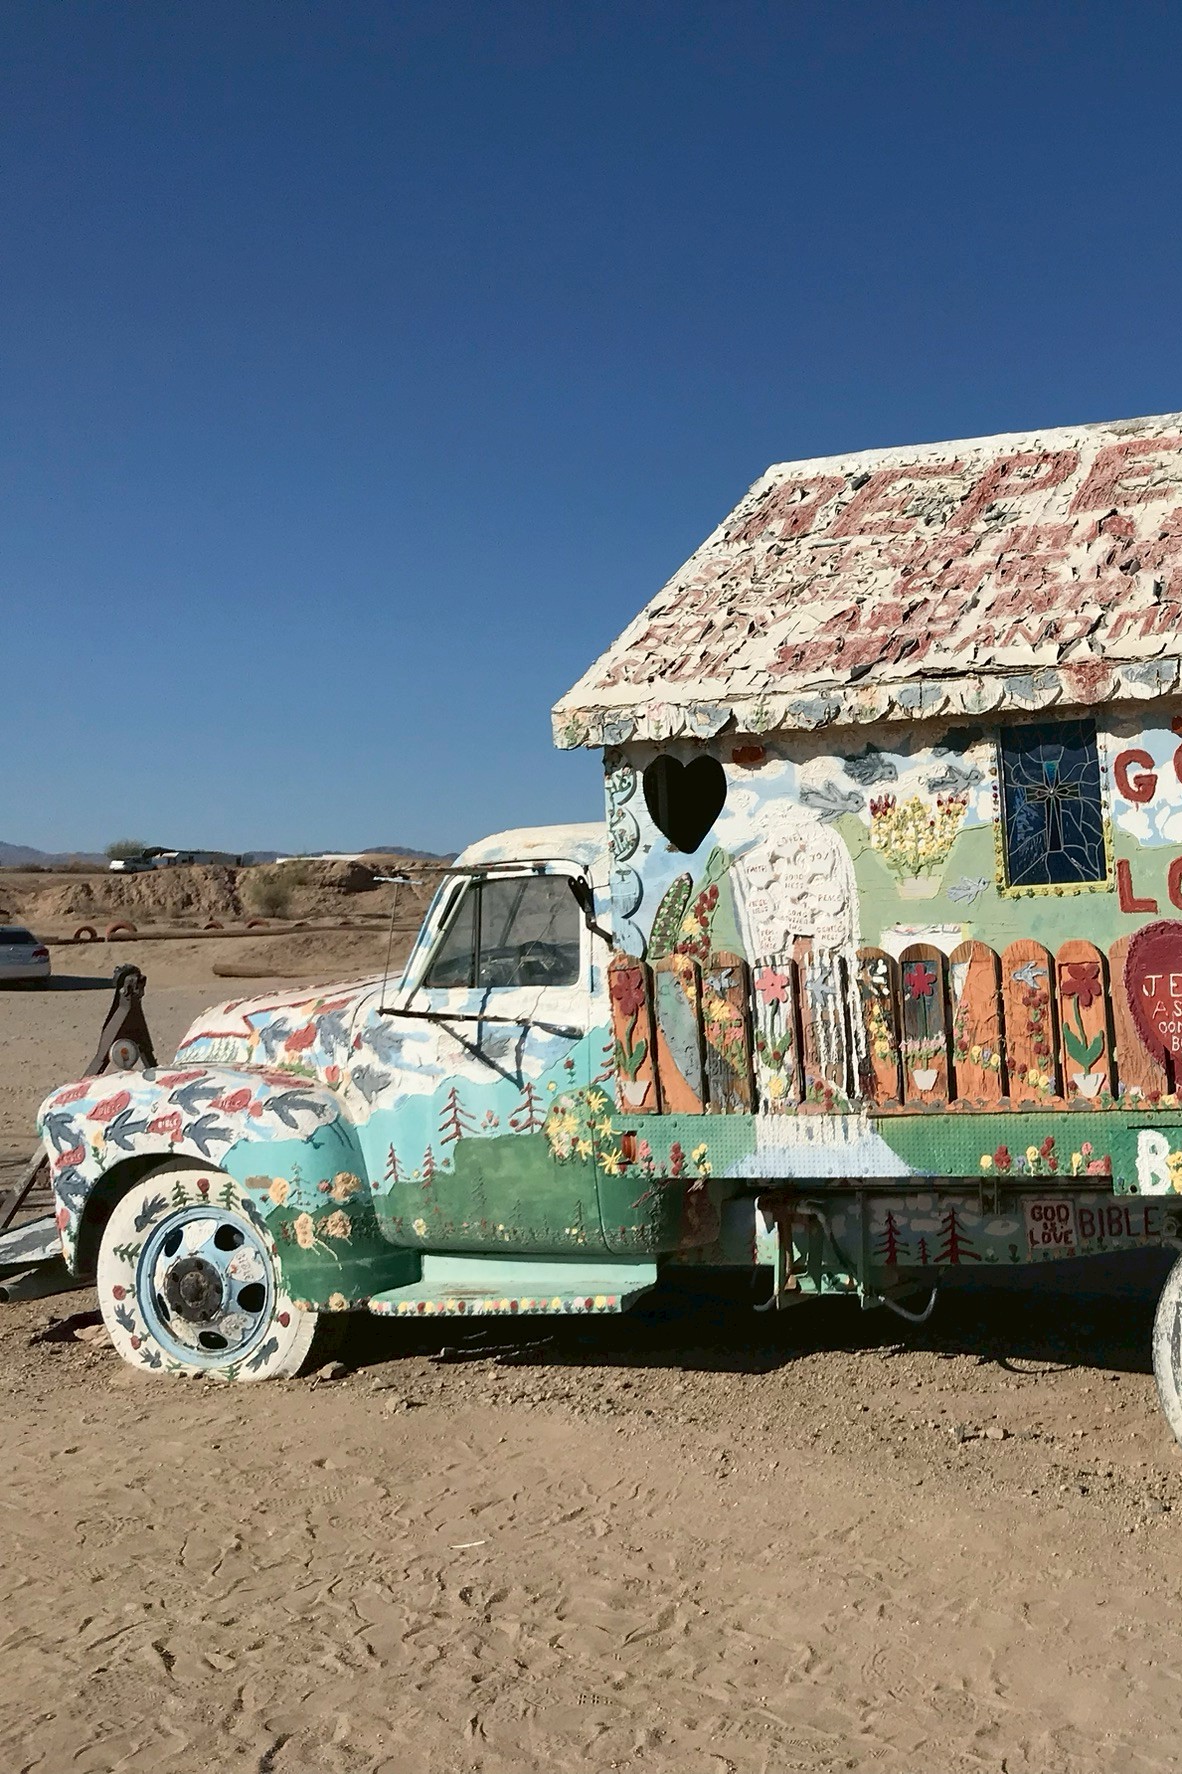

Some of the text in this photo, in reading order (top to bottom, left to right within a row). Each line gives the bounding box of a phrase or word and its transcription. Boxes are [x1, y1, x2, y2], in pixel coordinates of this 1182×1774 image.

[952, 612, 1100, 653] AND
[157, 1119, 178, 1129] BIBLE
[1031, 1204, 1070, 1222] GOD
[1078, 1206, 1161, 1239] BIBLE
[1029, 1228, 1073, 1247] LOVE
